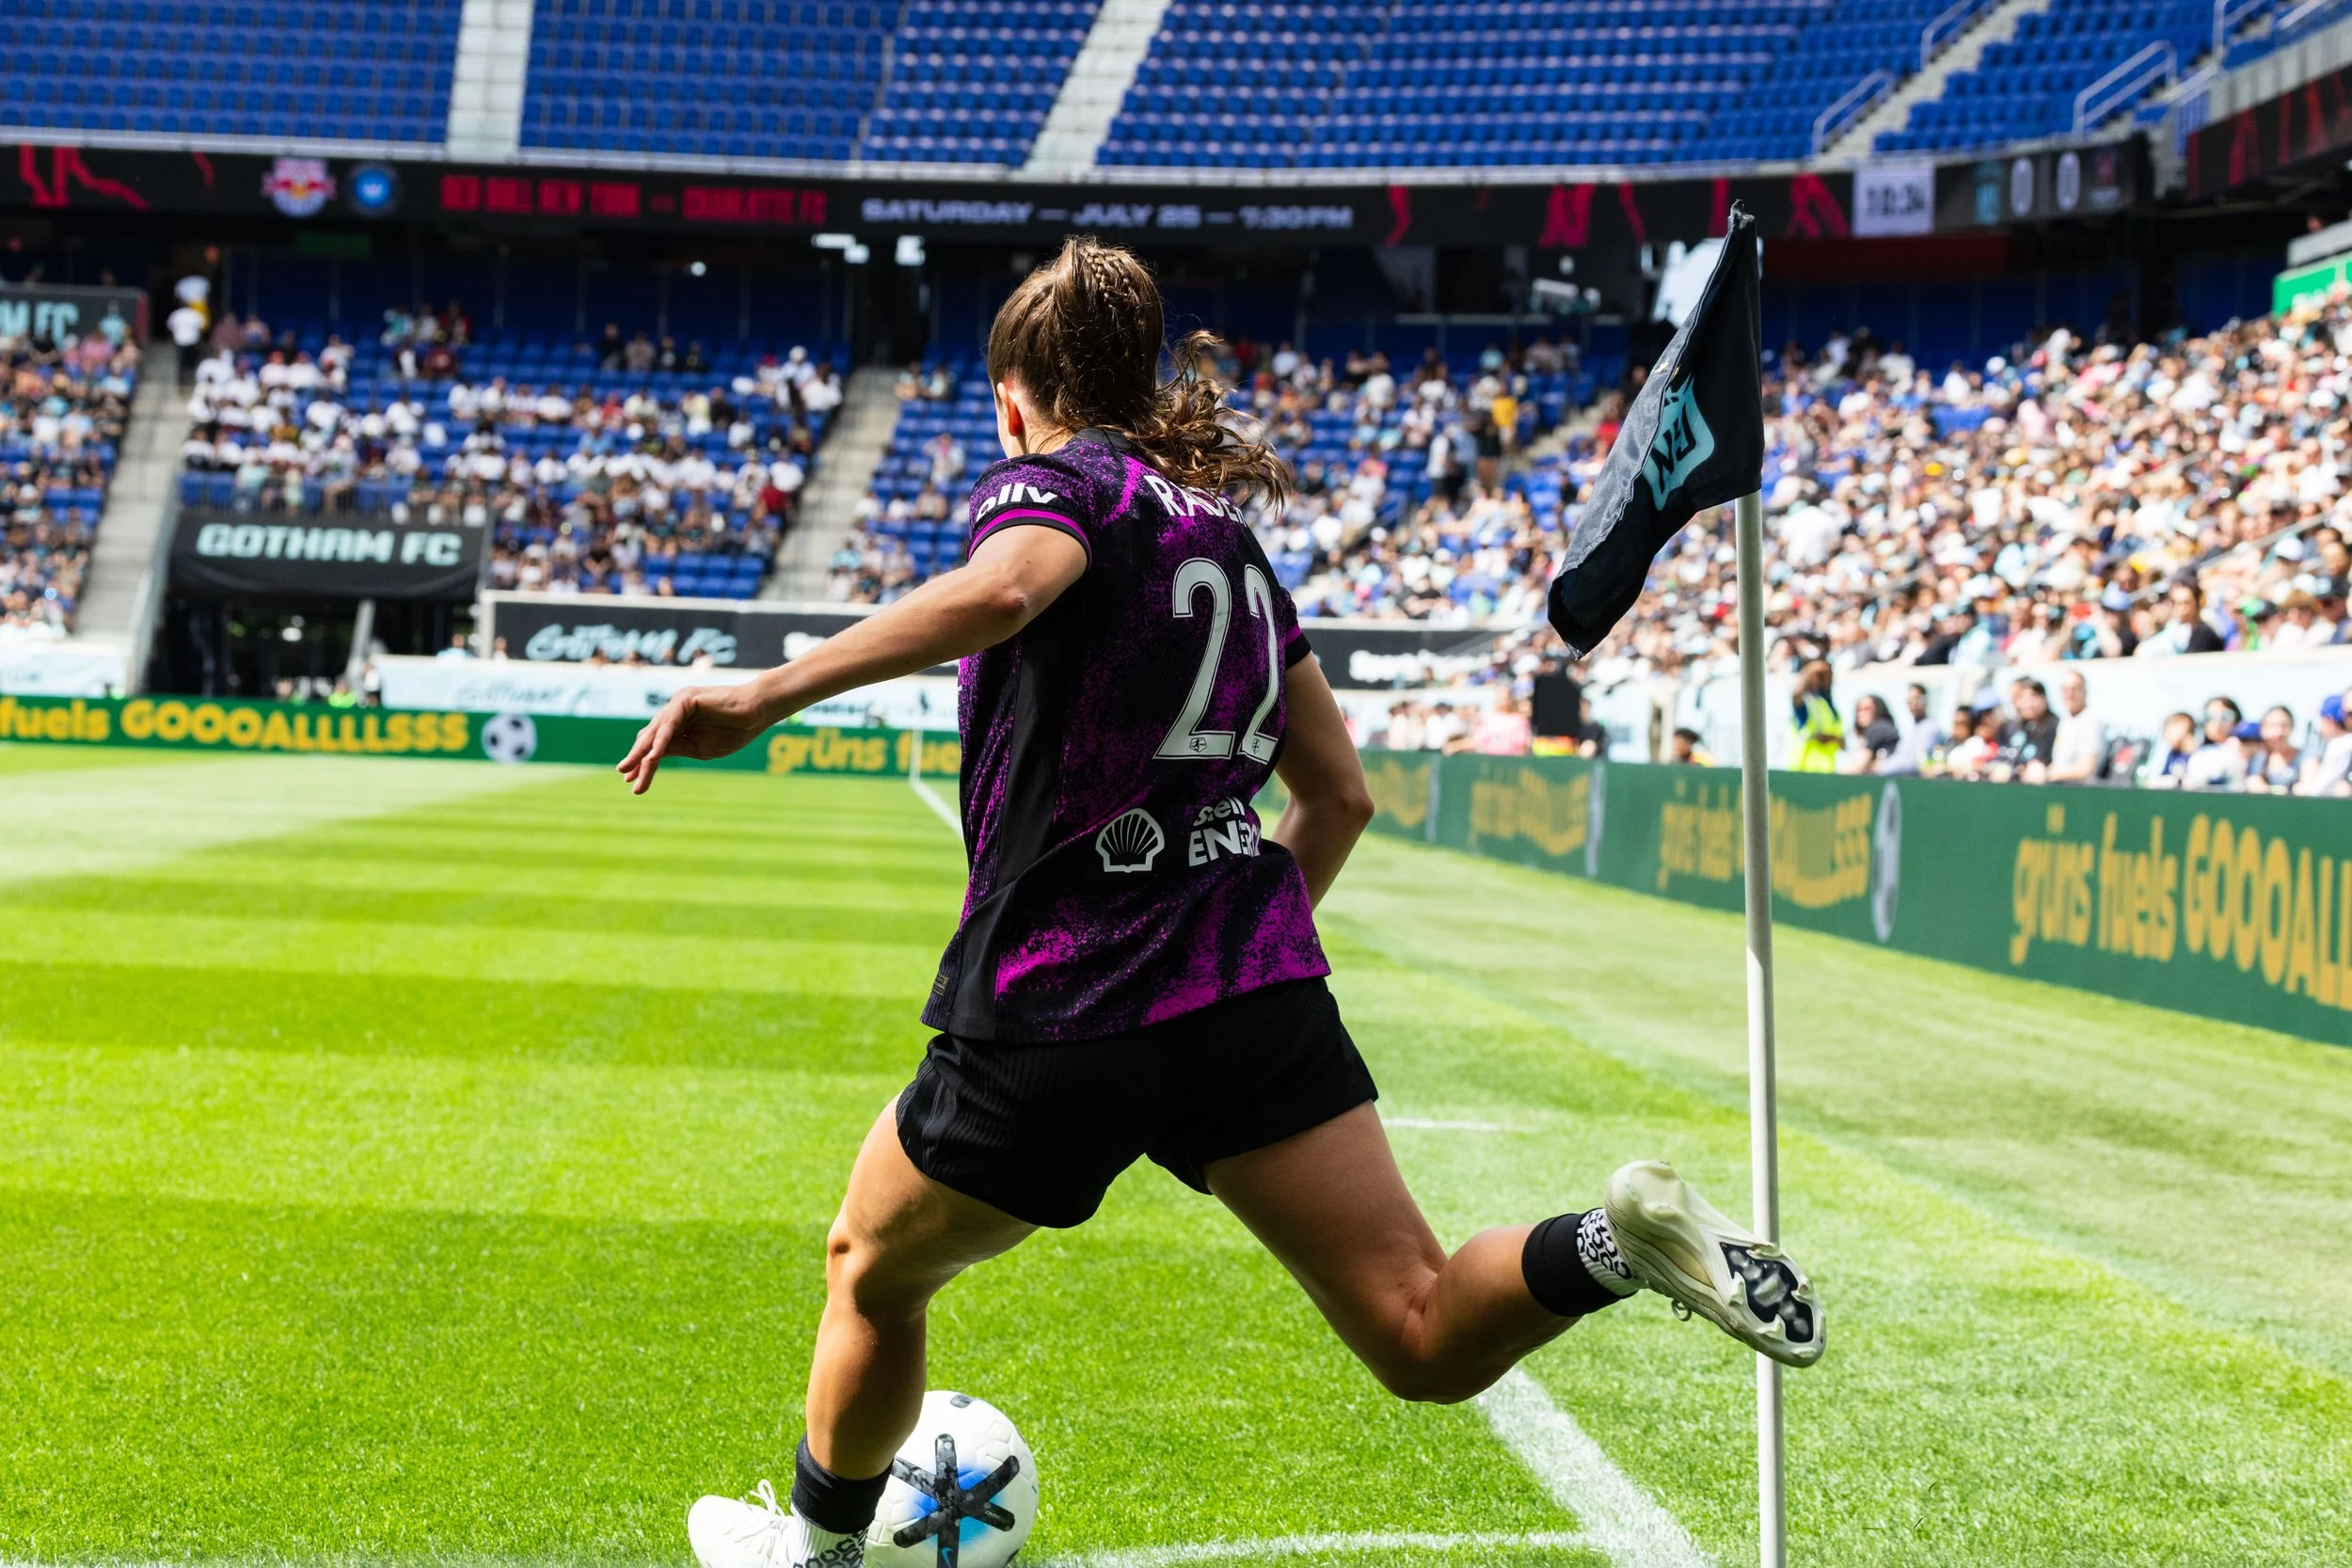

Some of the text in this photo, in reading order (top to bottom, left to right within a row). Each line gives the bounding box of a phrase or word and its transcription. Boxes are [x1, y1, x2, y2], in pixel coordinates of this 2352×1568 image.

[861, 198, 1033, 224] SATURDAY
[197, 523, 462, 566] GOTHAM FC
[1152, 557, 1279, 766] 22
[0, 696, 469, 752] fuels GOOOALLLLSSS
[767, 728, 961, 775] grüns fue
[2010, 802, 2095, 966] grüns
[2098, 811, 2178, 962] fuels
